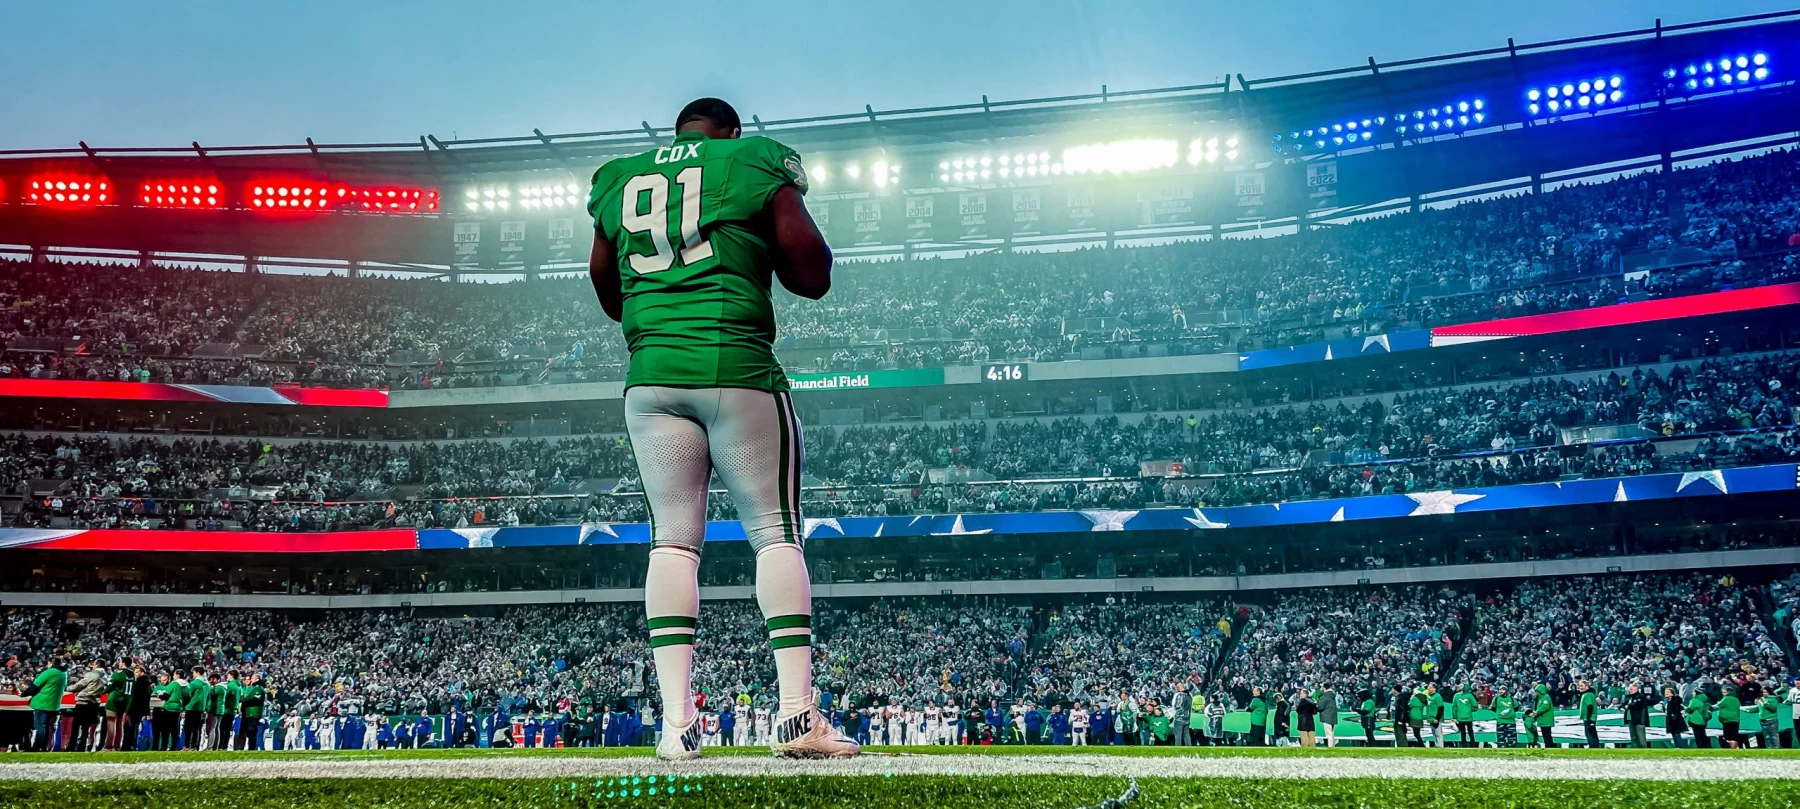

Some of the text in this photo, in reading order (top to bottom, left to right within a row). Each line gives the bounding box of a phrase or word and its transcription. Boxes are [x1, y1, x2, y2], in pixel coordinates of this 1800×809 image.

[654, 142, 703, 165] COX
[1309, 174, 1335, 185] 2022
[962, 204, 984, 213] 2006
[1016, 200, 1037, 210] 2010
[856, 211, 879, 220] 2003
[908, 207, 931, 217] 2004
[621, 166, 714, 276] 91
[456, 233, 477, 242] 1947
[503, 231, 522, 240] 1948
[552, 229, 571, 238] 1949
[986, 365, 1022, 381] 4:16
[838, 374, 870, 388] Field
[124, 681, 133, 695] 11
[757, 713, 767, 721] 73
[776, 709, 812, 744] NIKE
